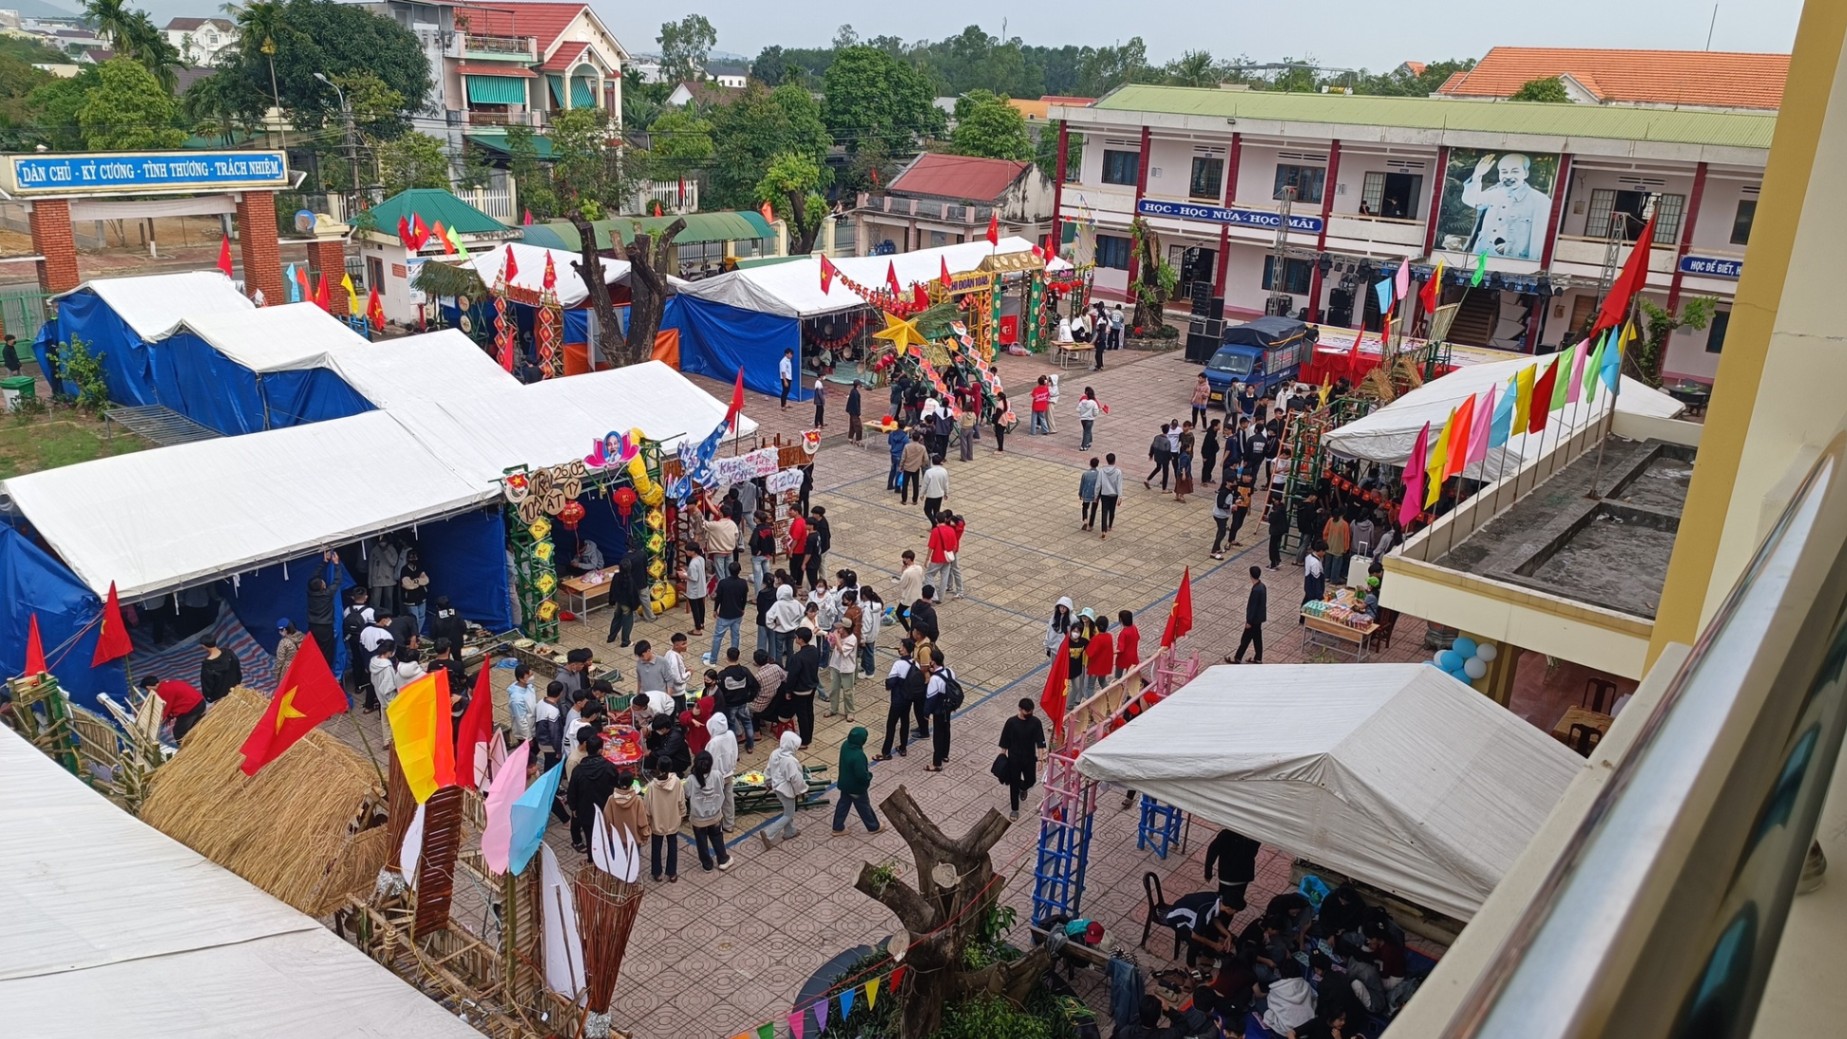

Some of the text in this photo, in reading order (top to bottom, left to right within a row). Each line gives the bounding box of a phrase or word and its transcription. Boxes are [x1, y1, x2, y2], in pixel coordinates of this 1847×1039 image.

[23, 163, 46, 182] DÂN
[49, 160, 71, 181] CHỦ
[82, 160, 96, 180] KỶ
[100, 163, 135, 179] CƯƠNG
[143, 160, 167, 177] TÌNH
[169, 162, 208, 177] THƯƠNG
[215, 158, 247, 176] TRÁCH
[249, 159, 279, 178] NHIỆM
[1145, 203, 1172, 214] HỌC
[1180, 207, 1208, 218] HỌC
[1212, 208, 1240, 221] NỮA
[1250, 214, 1280, 226] HỌC
[1287, 216, 1315, 229] MÃI
[1690, 260, 1705, 273] HỌC
[554, 466, 569, 481] 26
[570, 460, 585, 476] 03
